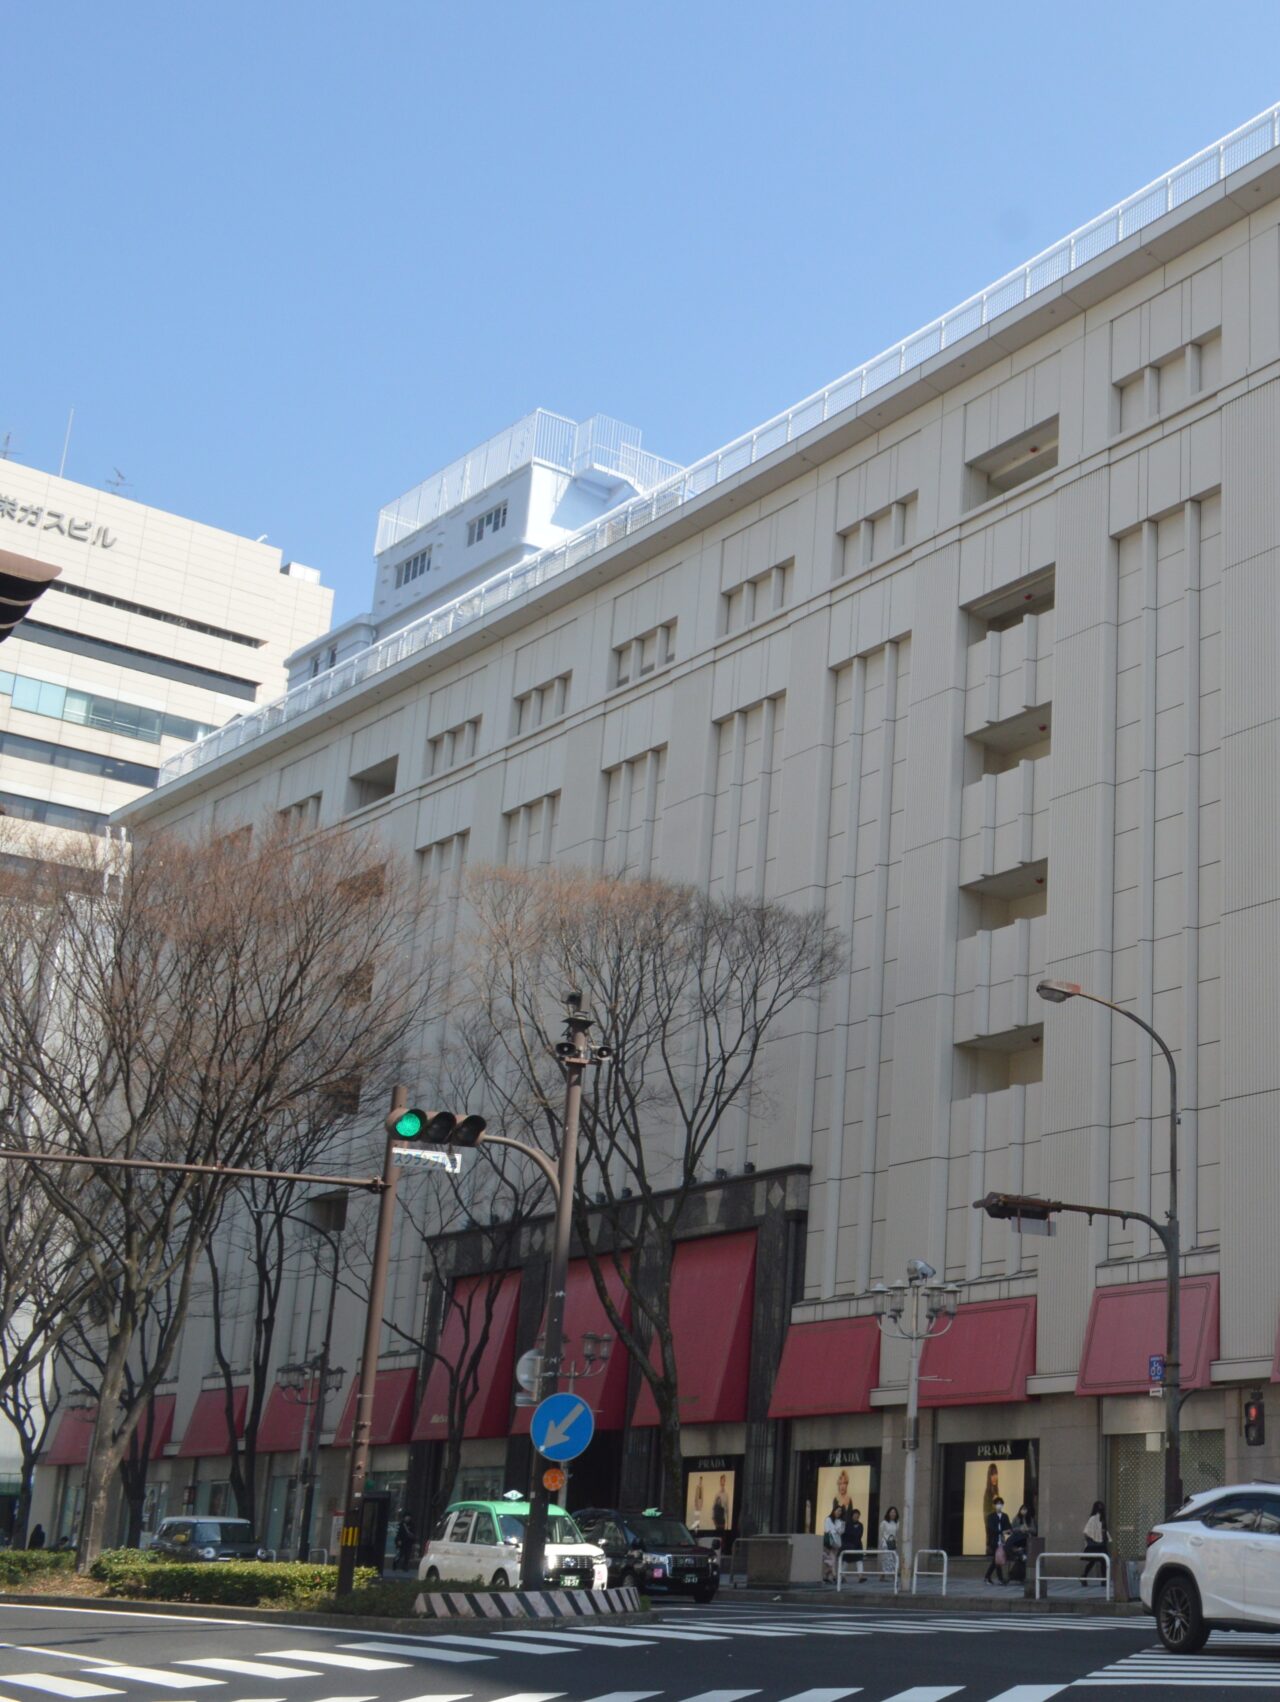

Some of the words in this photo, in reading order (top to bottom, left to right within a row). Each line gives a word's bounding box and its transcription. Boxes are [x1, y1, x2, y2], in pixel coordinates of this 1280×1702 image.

[978, 1444, 1012, 1456] PRADA
[829, 1450, 860, 1464] PRADA
[698, 1458, 726, 1469] PRADA
